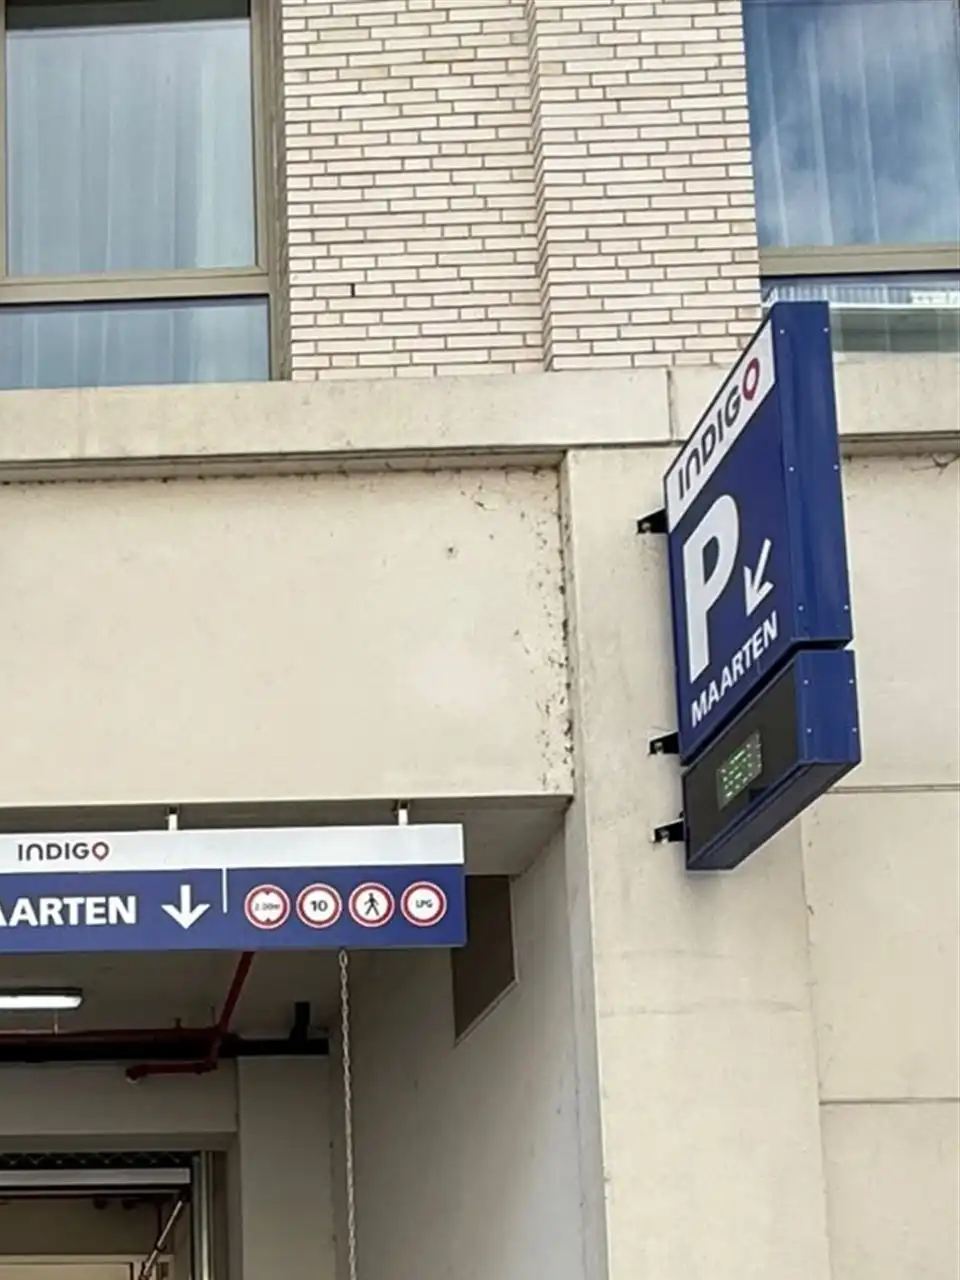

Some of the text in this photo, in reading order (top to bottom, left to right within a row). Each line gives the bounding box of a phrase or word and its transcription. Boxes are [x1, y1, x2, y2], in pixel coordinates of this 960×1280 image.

[678, 357, 761, 500] INDIGO
[682, 494, 739, 684] P
[691, 610, 778, 728] MAARTEN
[17, 841, 110, 862] INDIGO
[311, 900, 328, 912] 10
[415, 899, 433, 908] LPG
